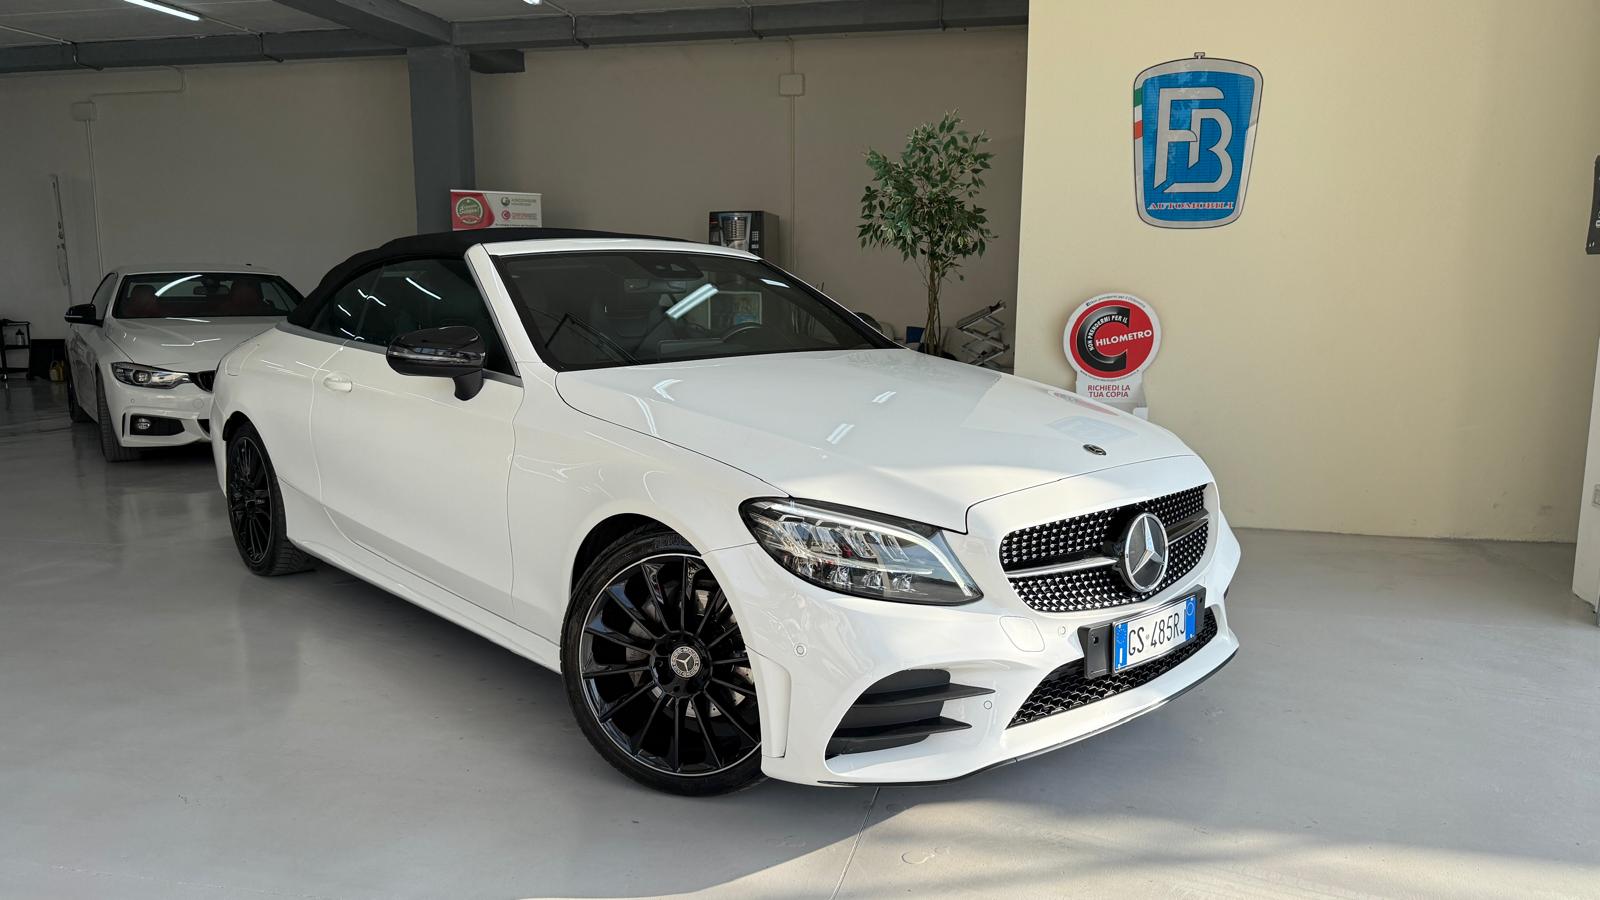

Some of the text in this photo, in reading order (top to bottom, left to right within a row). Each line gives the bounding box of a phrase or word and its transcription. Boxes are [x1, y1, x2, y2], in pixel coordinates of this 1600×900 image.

[1153, 87, 1233, 193] FB
[1148, 201, 1234, 210] AUTOMOBILI
[1087, 316, 1111, 339] PRENDERMI
[1122, 316, 1128, 324] IL
[1087, 340, 1095, 352] NON
[1095, 329, 1153, 346] HILOMETRO
[1128, 609, 1186, 656] GS 485RJ
